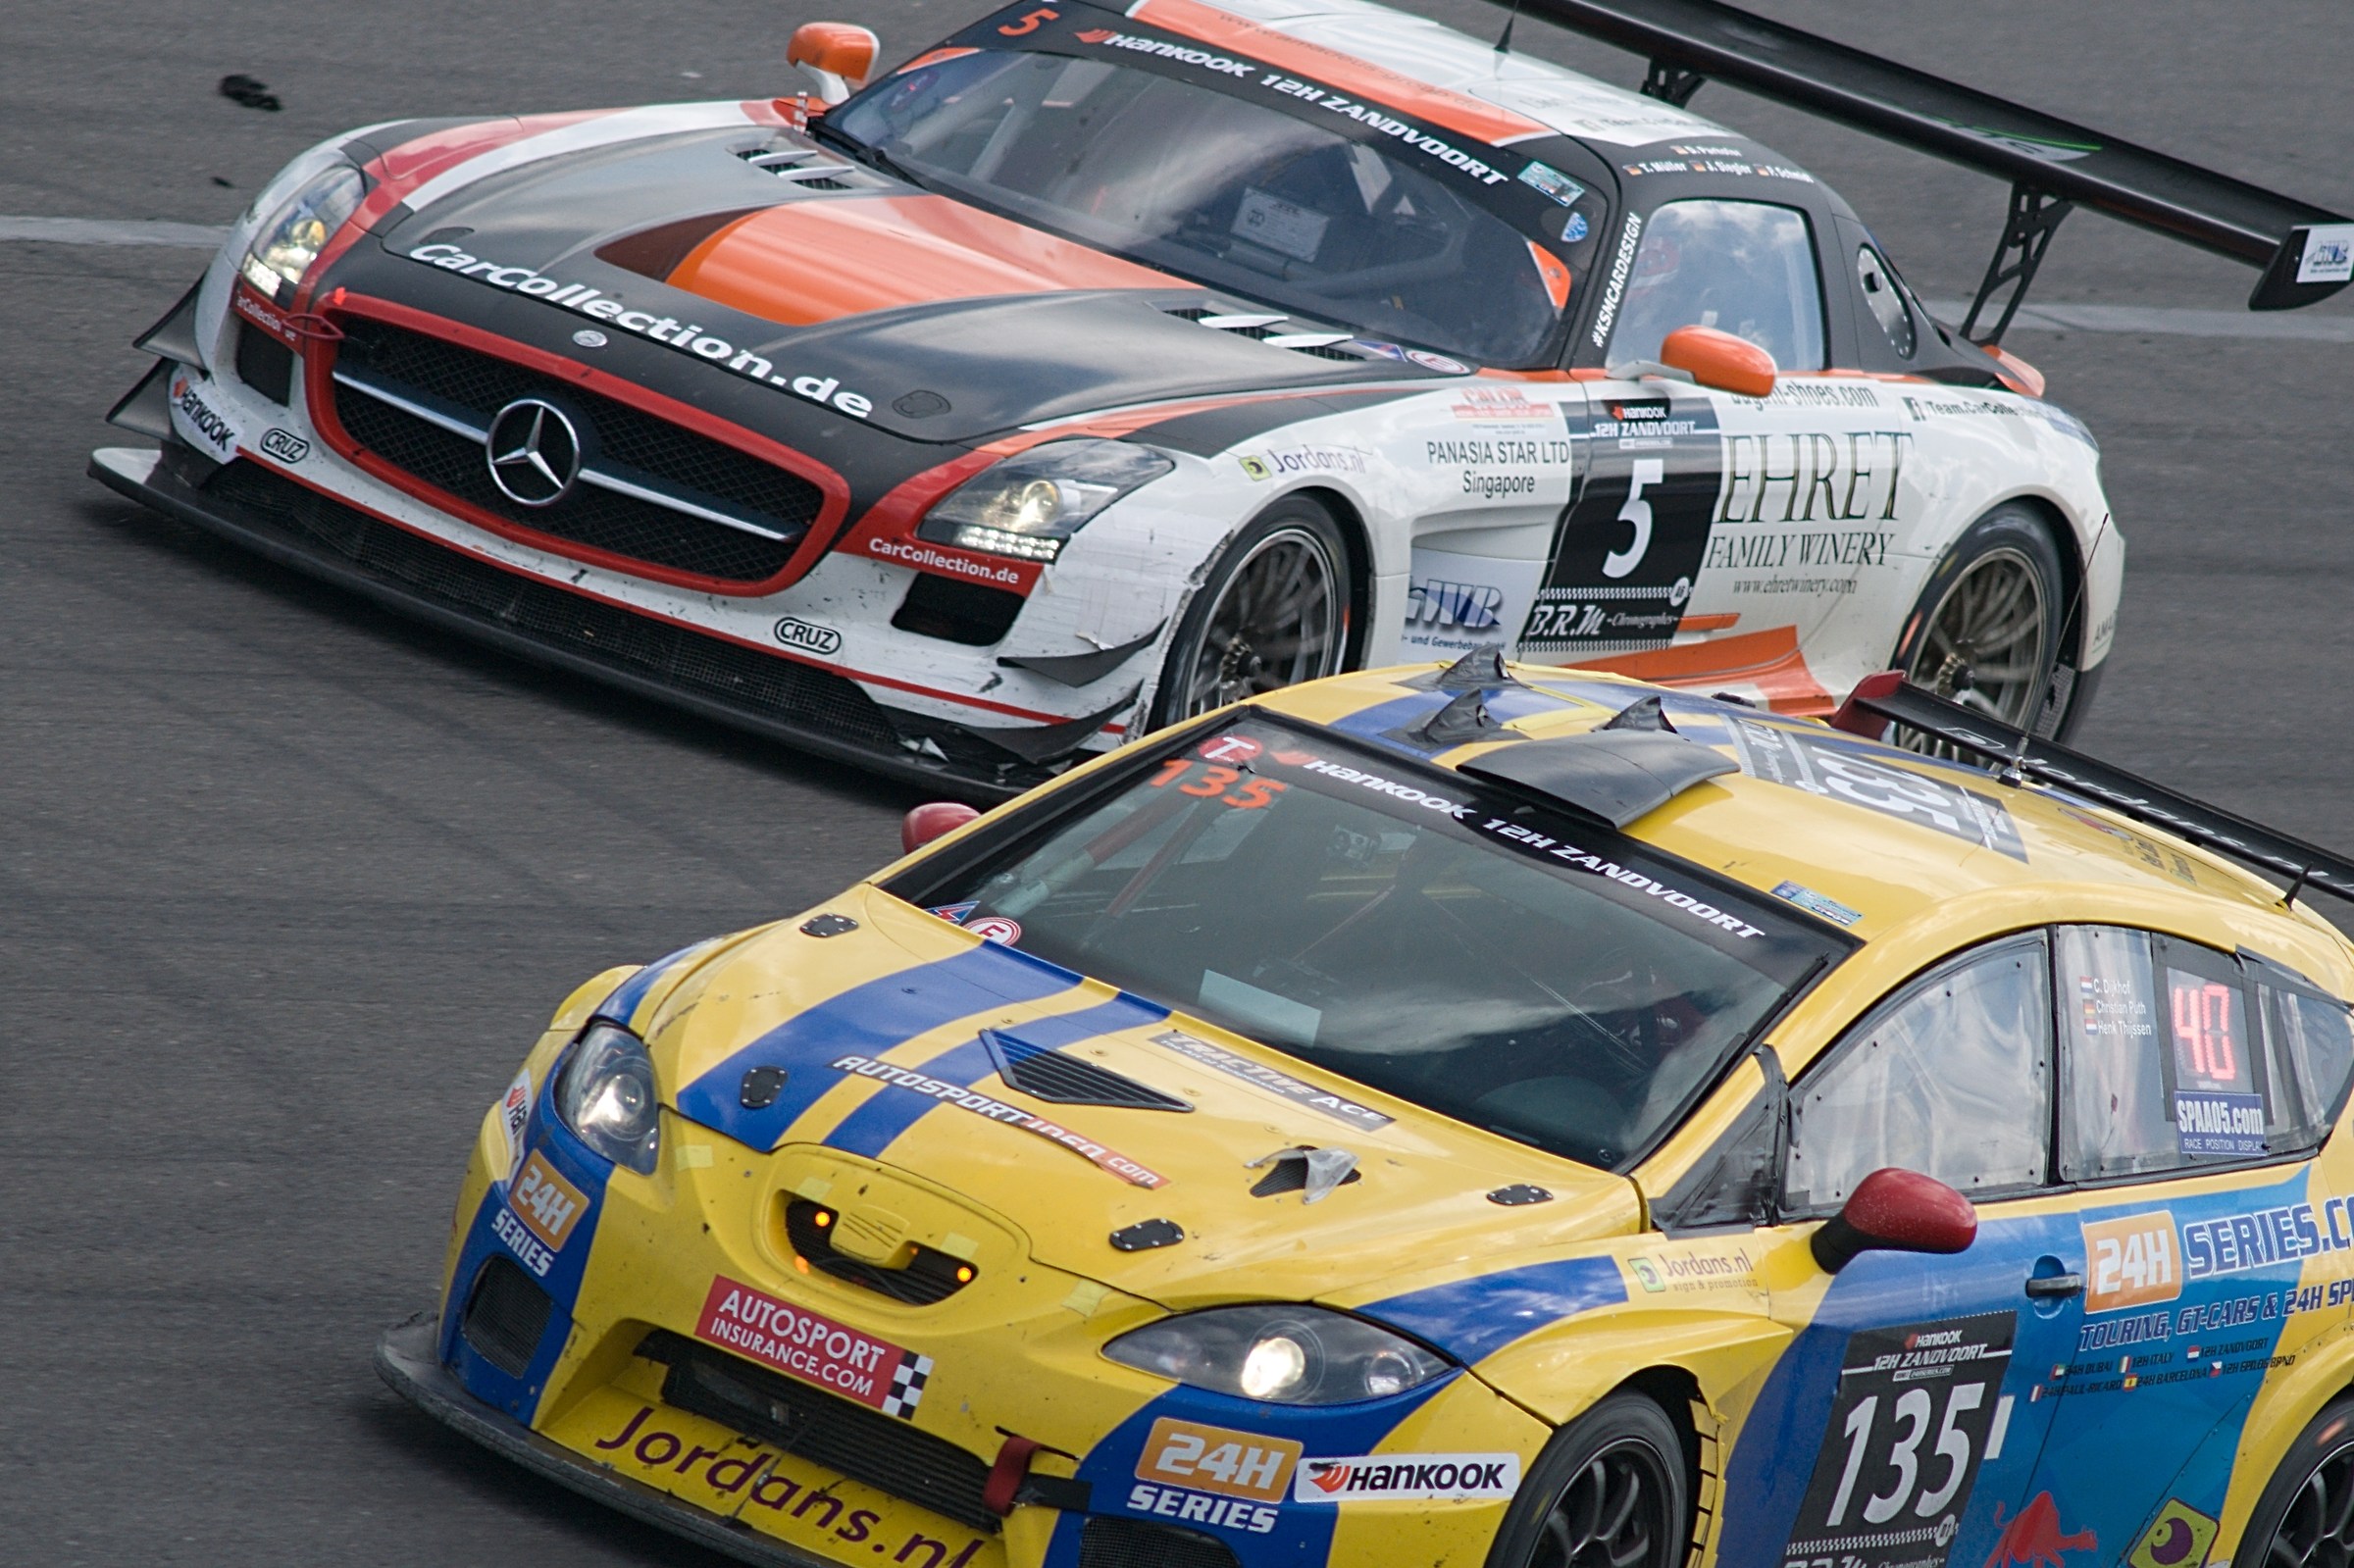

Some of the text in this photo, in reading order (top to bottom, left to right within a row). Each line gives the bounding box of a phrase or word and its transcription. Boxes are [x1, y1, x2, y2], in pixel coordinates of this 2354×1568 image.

[998, 8, 1060, 36] 5
[1260, 74, 1324, 102] 12H
[1319, 95, 1509, 186] ZANDVOORT
[1591, 212, 1642, 348] #KSMCARDESIGN
[409, 243, 873, 419] CarCollection.de
[266, 432, 304, 460] CRUZ
[1595, 421, 1695, 437] 12H ZANDVOORT
[1269, 445, 1367, 475] Jordans.nl
[1427, 441, 1569, 465] PANASIA STAR LTD
[1462, 471, 1535, 499] Singapore
[1714, 431, 1914, 524] EHRET
[1602, 459, 1663, 579] 5
[869, 537, 1019, 584] CarCollection.de
[1706, 532, 1896, 569] FAMILY WINERY
[780, 620, 833, 649] CRUZ
[1151, 758, 1288, 810] 135
[1482, 818, 1556, 849] 12H
[1552, 845, 1766, 939] ZANDVOORT
[2093, 979, 2103, 993] C.
[2096, 999, 2128, 1014] Christian
[2098, 1020, 2152, 1039] Henk Thijssen
[2174, 985, 2236, 1081] 40
[1309, 1095, 1388, 1122] ACE
[2183, 1138, 2203, 1150] RACE
[2205, 1138, 2235, 1151] POSITION
[516, 1164, 576, 1237] 24H
[491, 1207, 554, 1277] SERIES
[1659, 1246, 1754, 1277] Jordans.nl
[2096, 1230, 2172, 1294] 24H
[1673, 1282, 1694, 1293] sign
[1708, 1277, 1759, 1292] promotion
[719, 1290, 886, 1373] AUTOSPORT
[2079, 1312, 2173, 1352] TOURING,
[2176, 1295, 2261, 1337] GT-CARS
[2261, 1292, 2277, 1320] &
[2281, 1285, 2324, 1317] 24H
[711, 1317, 874, 1396] INSURANCE.COM
[1873, 1343, 1988, 1371] 12H ZANDVOORT
[2149, 1352, 2175, 1366] ITALY
[1155, 1433, 1286, 1491] 24H
[1826, 1383, 1985, 1527] 135
[594, 1406, 985, 1568] Jordans.nl
[1127, 1486, 1278, 1534] SERIES
